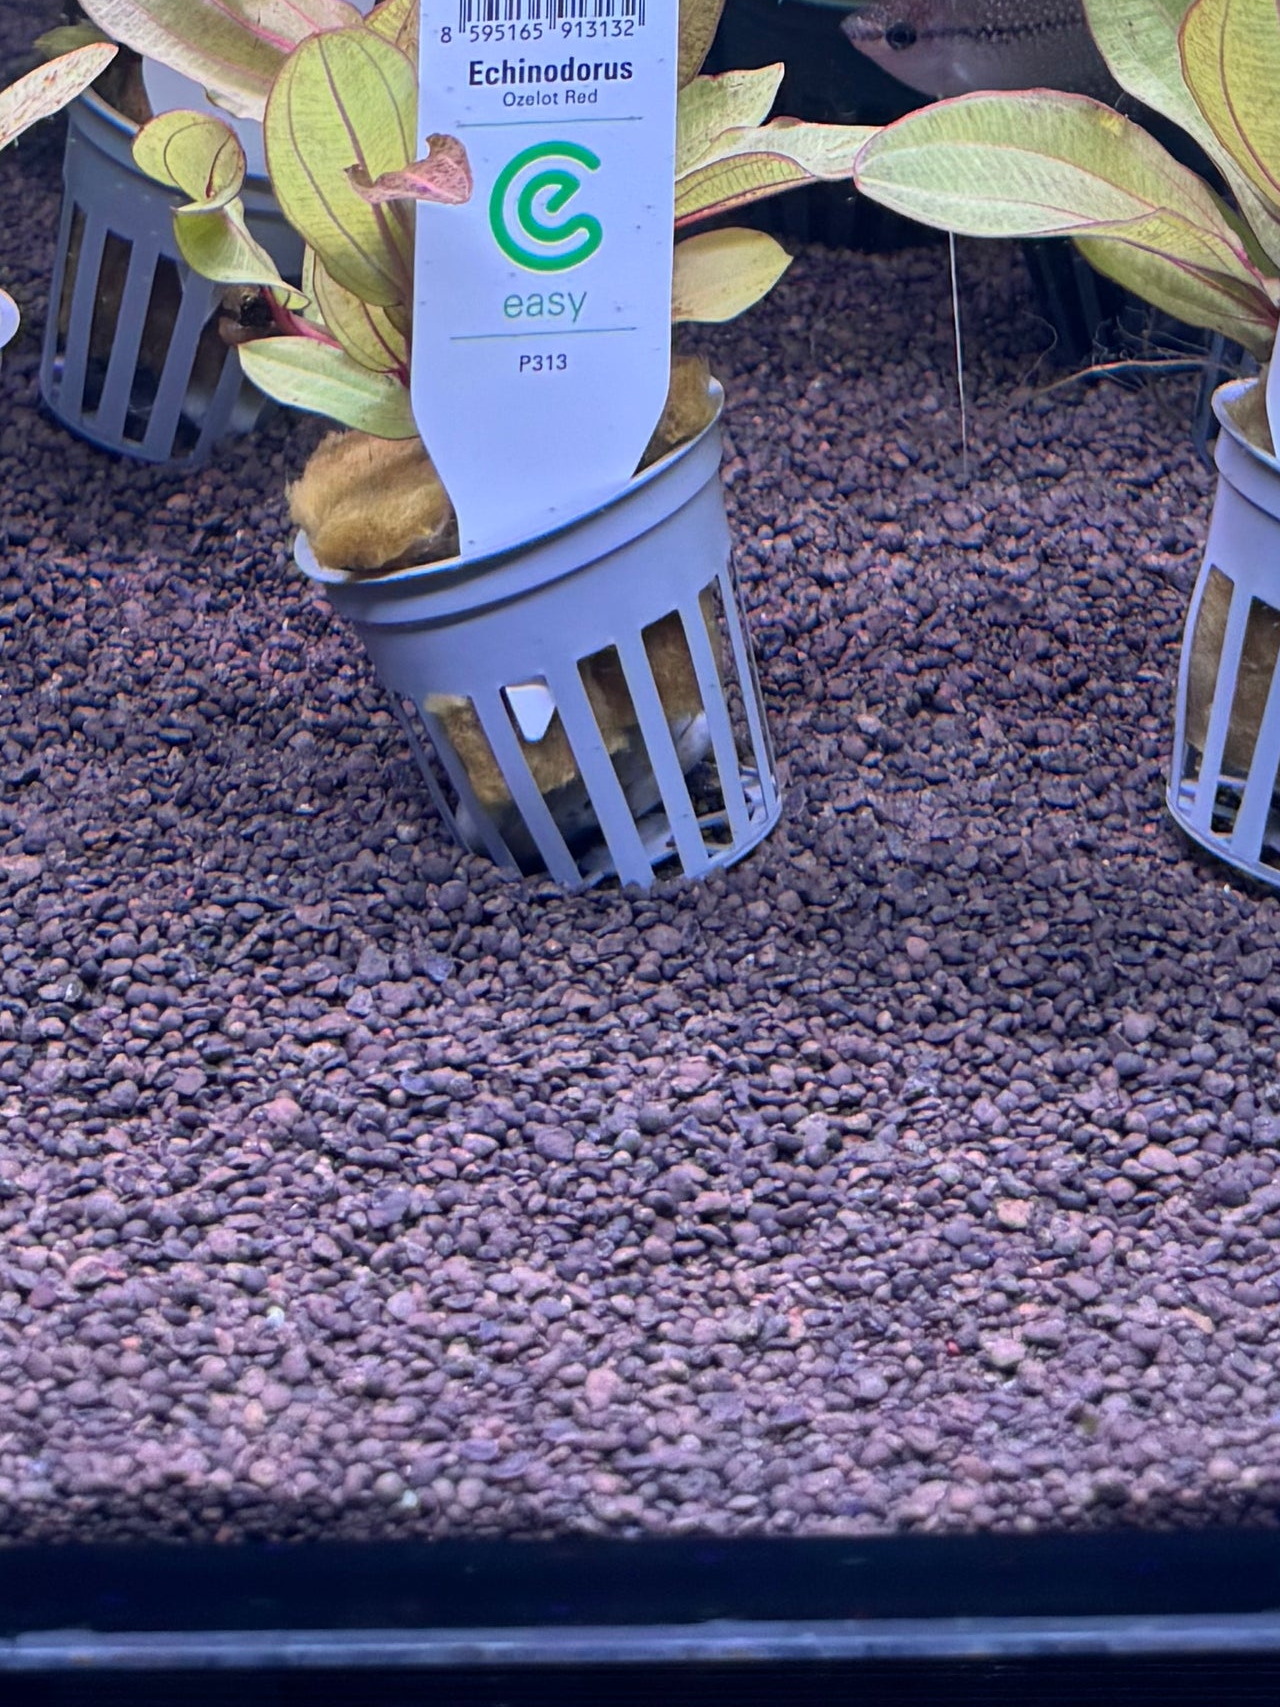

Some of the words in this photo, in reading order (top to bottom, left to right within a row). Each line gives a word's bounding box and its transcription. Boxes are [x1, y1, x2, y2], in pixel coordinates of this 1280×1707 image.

[440, 26, 452, 44] 8
[469, 22, 543, 43] 595165
[561, 19, 635, 39] 913132
[469, 56, 633, 86] Echinodorus
[503, 90, 558, 107] Ozelot
[565, 88, 598, 105] Red
[503, 291, 587, 323] easy
[519, 354, 568, 373] P313
